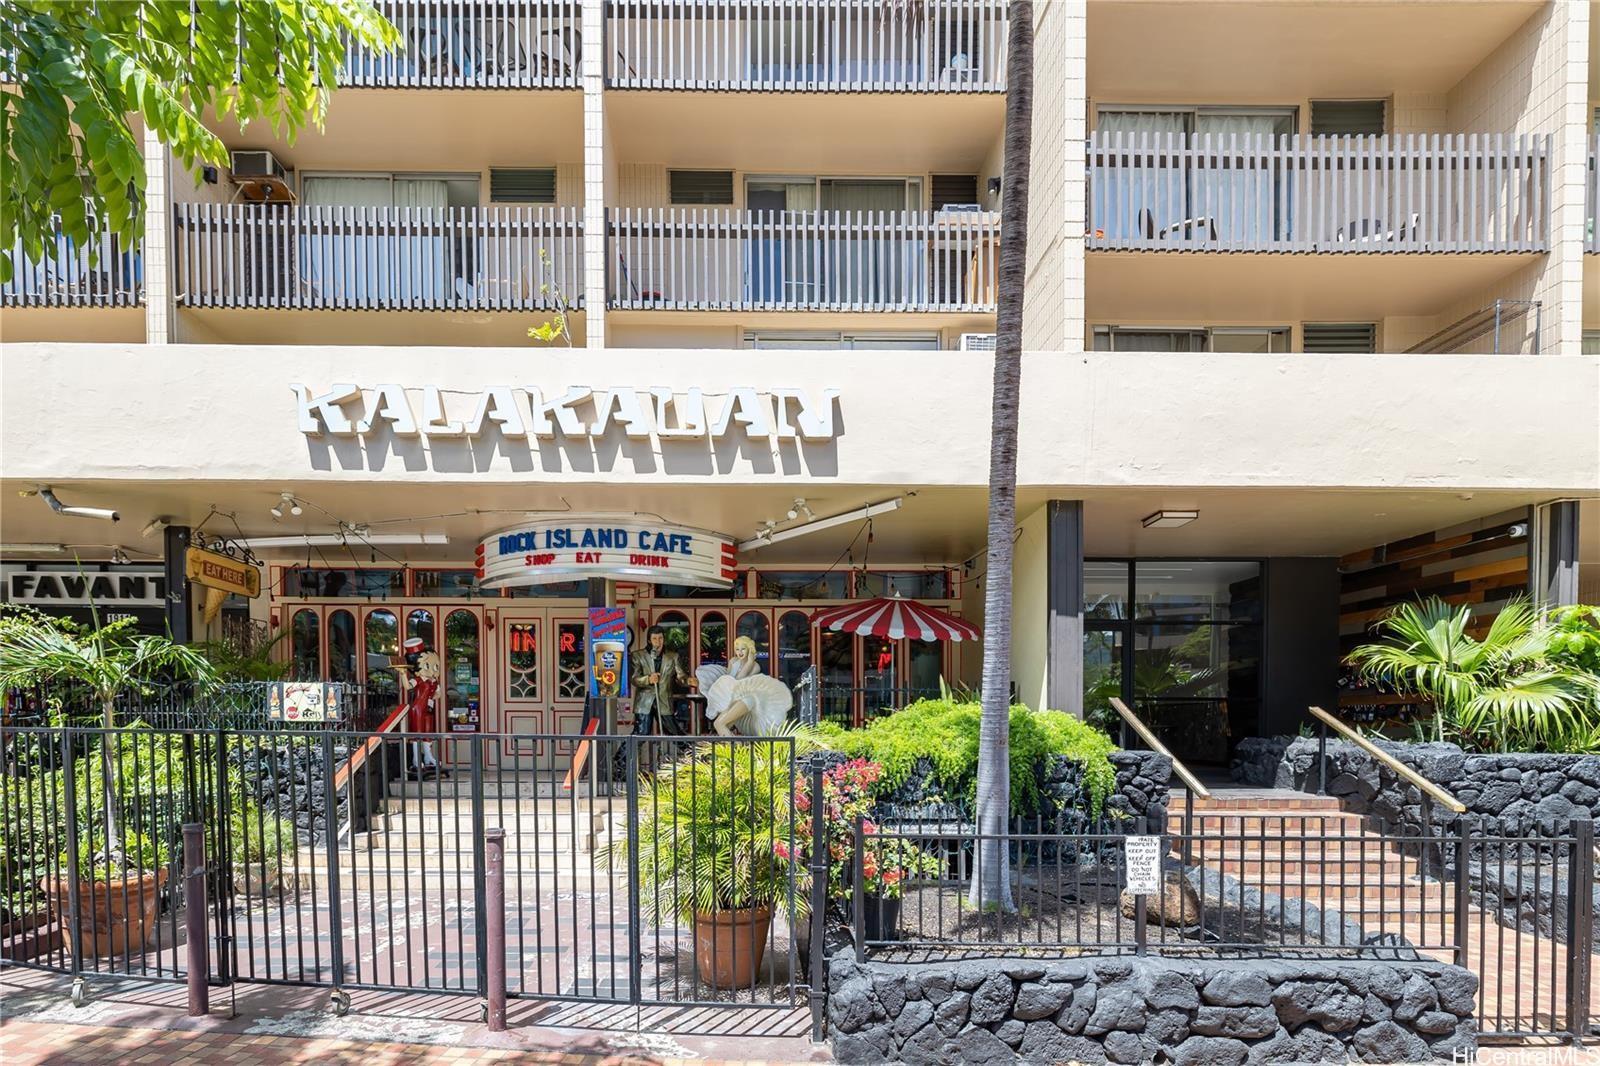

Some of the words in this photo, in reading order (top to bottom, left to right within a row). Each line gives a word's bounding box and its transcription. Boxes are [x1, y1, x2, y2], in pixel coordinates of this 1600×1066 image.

[289, 383, 841, 441] KALAKAUAN
[498, 531, 537, 555] ROCK
[546, 528, 628, 549] ISLAND
[638, 530, 692, 555] CAFE
[525, 553, 556, 567] SHOP
[575, 551, 602, 564] EAT
[629, 553, 669, 568] DRINK
[205, 562, 221, 577] EAT
[222, 567, 243, 584] HERE
